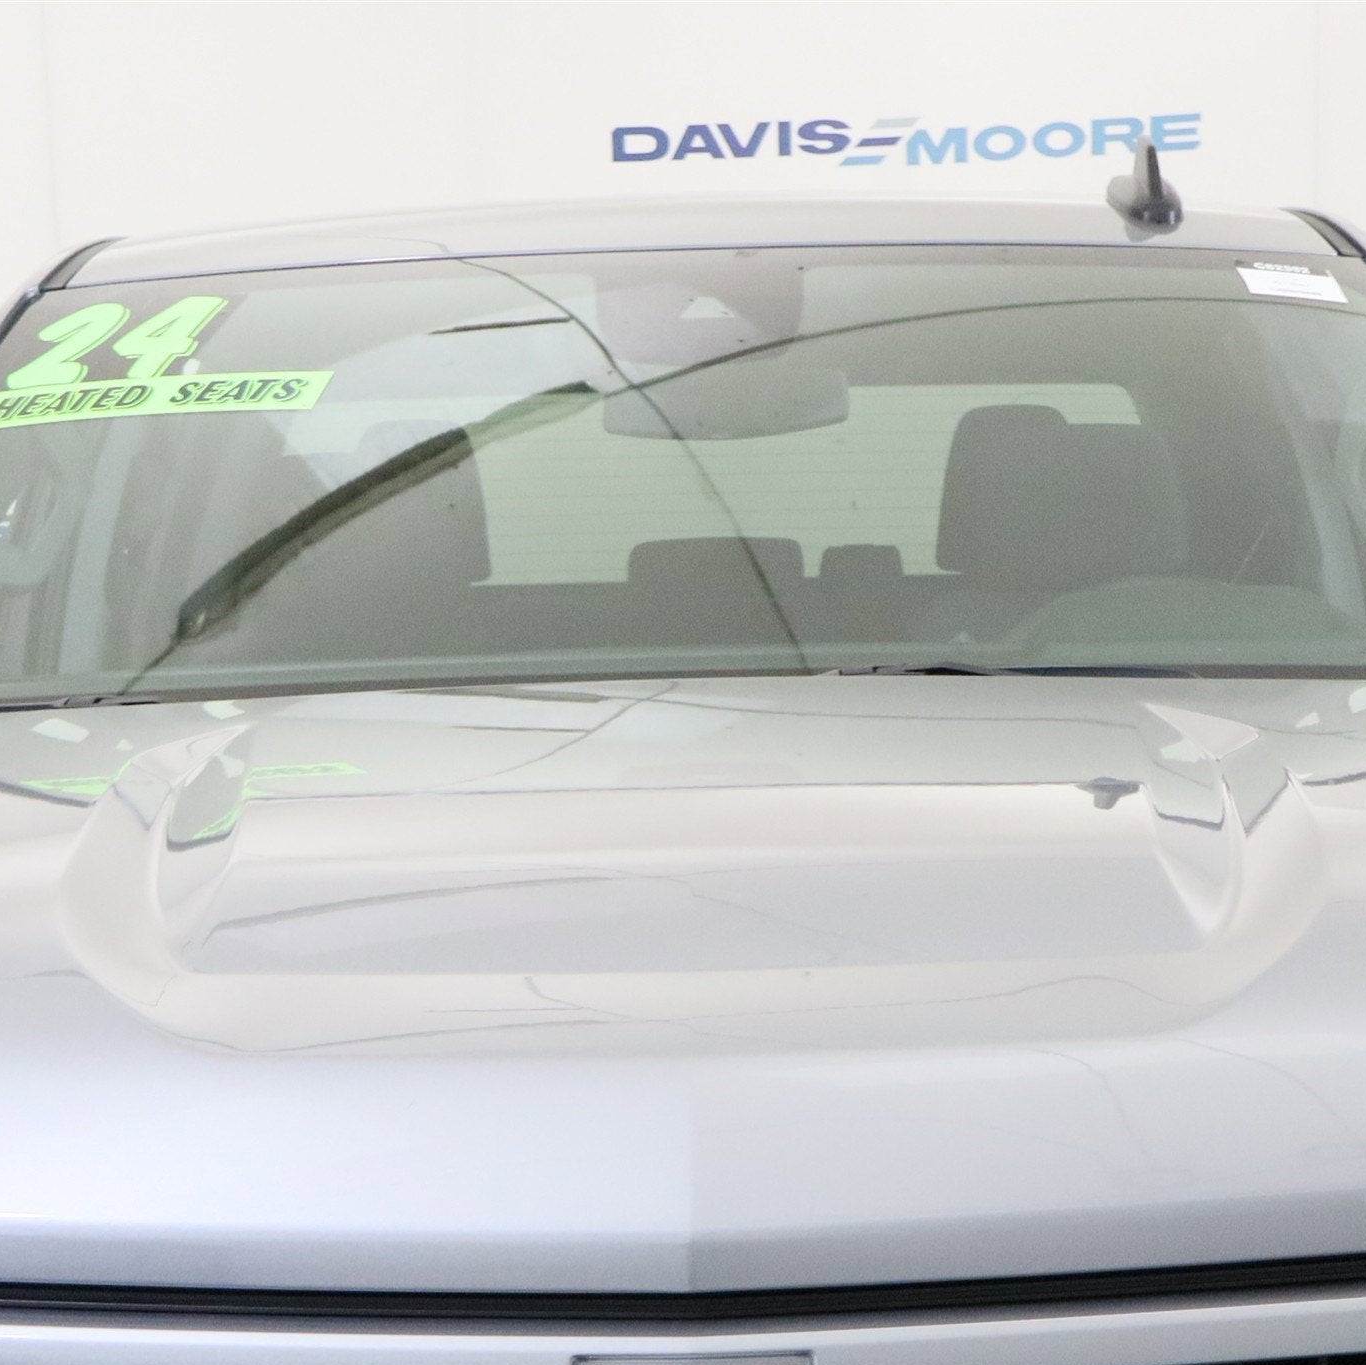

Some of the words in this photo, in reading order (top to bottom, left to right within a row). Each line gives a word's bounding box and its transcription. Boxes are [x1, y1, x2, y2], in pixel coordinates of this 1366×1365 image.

[611, 118, 853, 162] DAVIS
[905, 113, 1202, 166] MOORE
[6, 297, 230, 390] 24
[168, 377, 310, 407] SEATS
